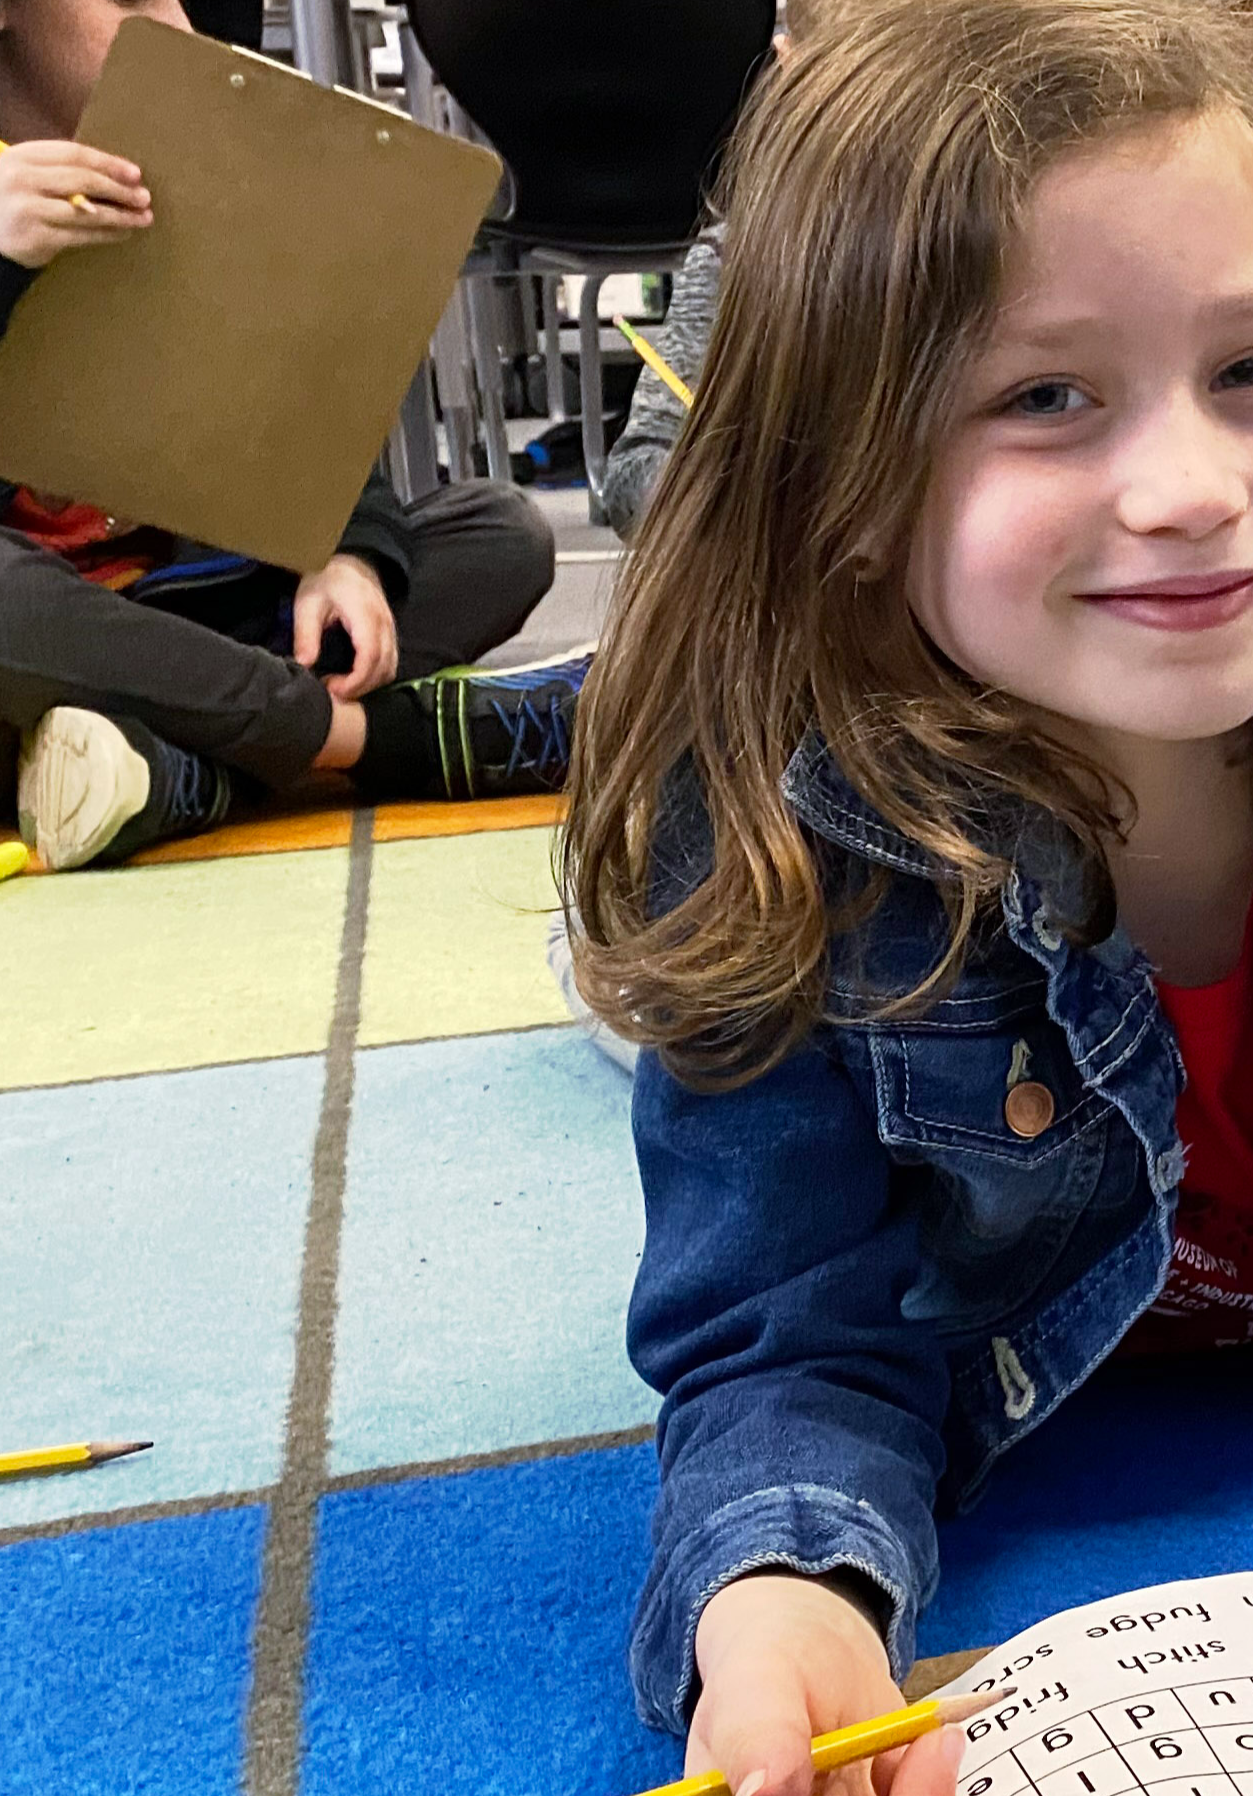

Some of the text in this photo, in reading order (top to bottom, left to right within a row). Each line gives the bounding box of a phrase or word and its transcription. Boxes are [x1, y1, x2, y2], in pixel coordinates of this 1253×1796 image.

[1159, 1289, 1211, 1311] CAGO
[1086, 1602, 1213, 1640] fudge
[1117, 1640, 1227, 1676] stitch
[1208, 1689, 1237, 1706] u
[966, 1681, 1070, 1743] fridg
[1124, 1704, 1157, 1730] d
[1041, 1727, 1074, 1754] g
[1149, 1736, 1183, 1760] g
[967, 1776, 993, 1796] e
